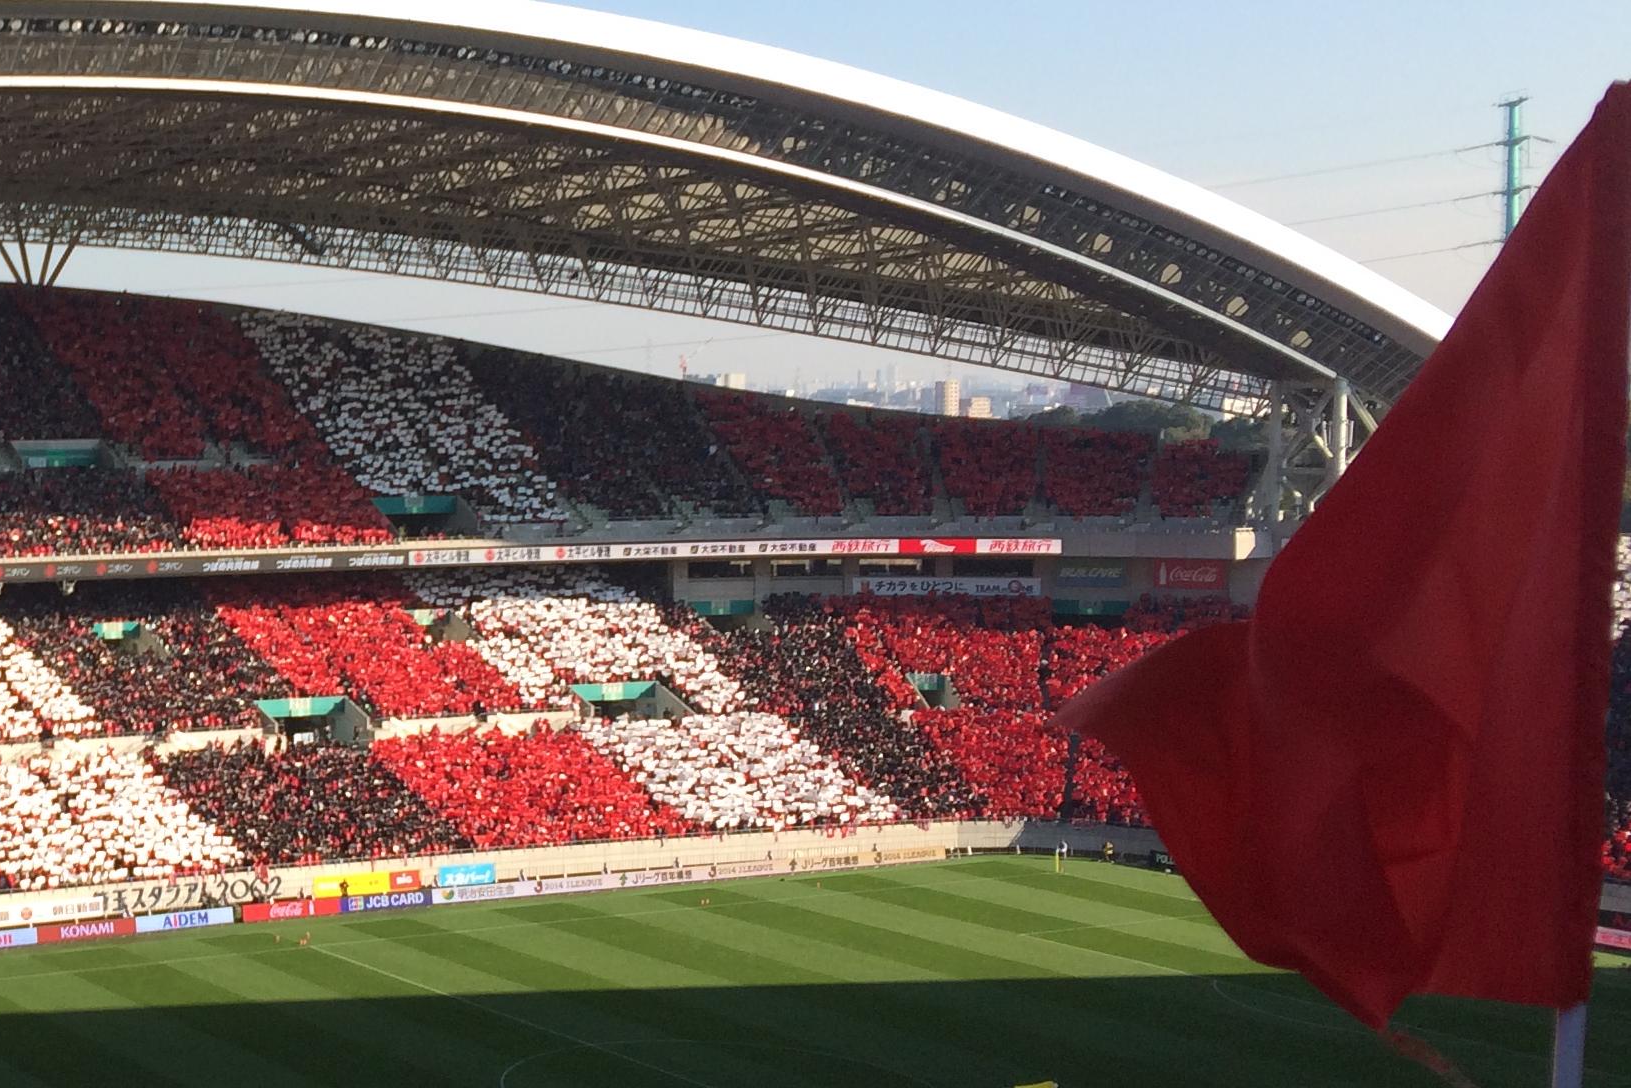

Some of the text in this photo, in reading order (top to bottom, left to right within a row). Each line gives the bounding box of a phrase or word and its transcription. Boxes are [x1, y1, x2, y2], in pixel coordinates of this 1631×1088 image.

[634, 546, 677, 555] 大栄不動産
[701, 544, 745, 553] 大栄不動産
[770, 543, 817, 552] 大栄不動産
[832, 540, 891, 552] 西鉄旅行
[989, 539, 1053, 552] 西鉄旅行
[802, 856, 859, 870] Jリーグ百年構想
[632, 869, 693, 885] Jリーグ百年構想
[366, 895, 389, 908] JCB
[391, 892, 424, 906] CARD
[53, 902, 100, 916] 朝日新聞
[162, 911, 208, 928] AIDEM
[60, 922, 115, 938] KONAMI
